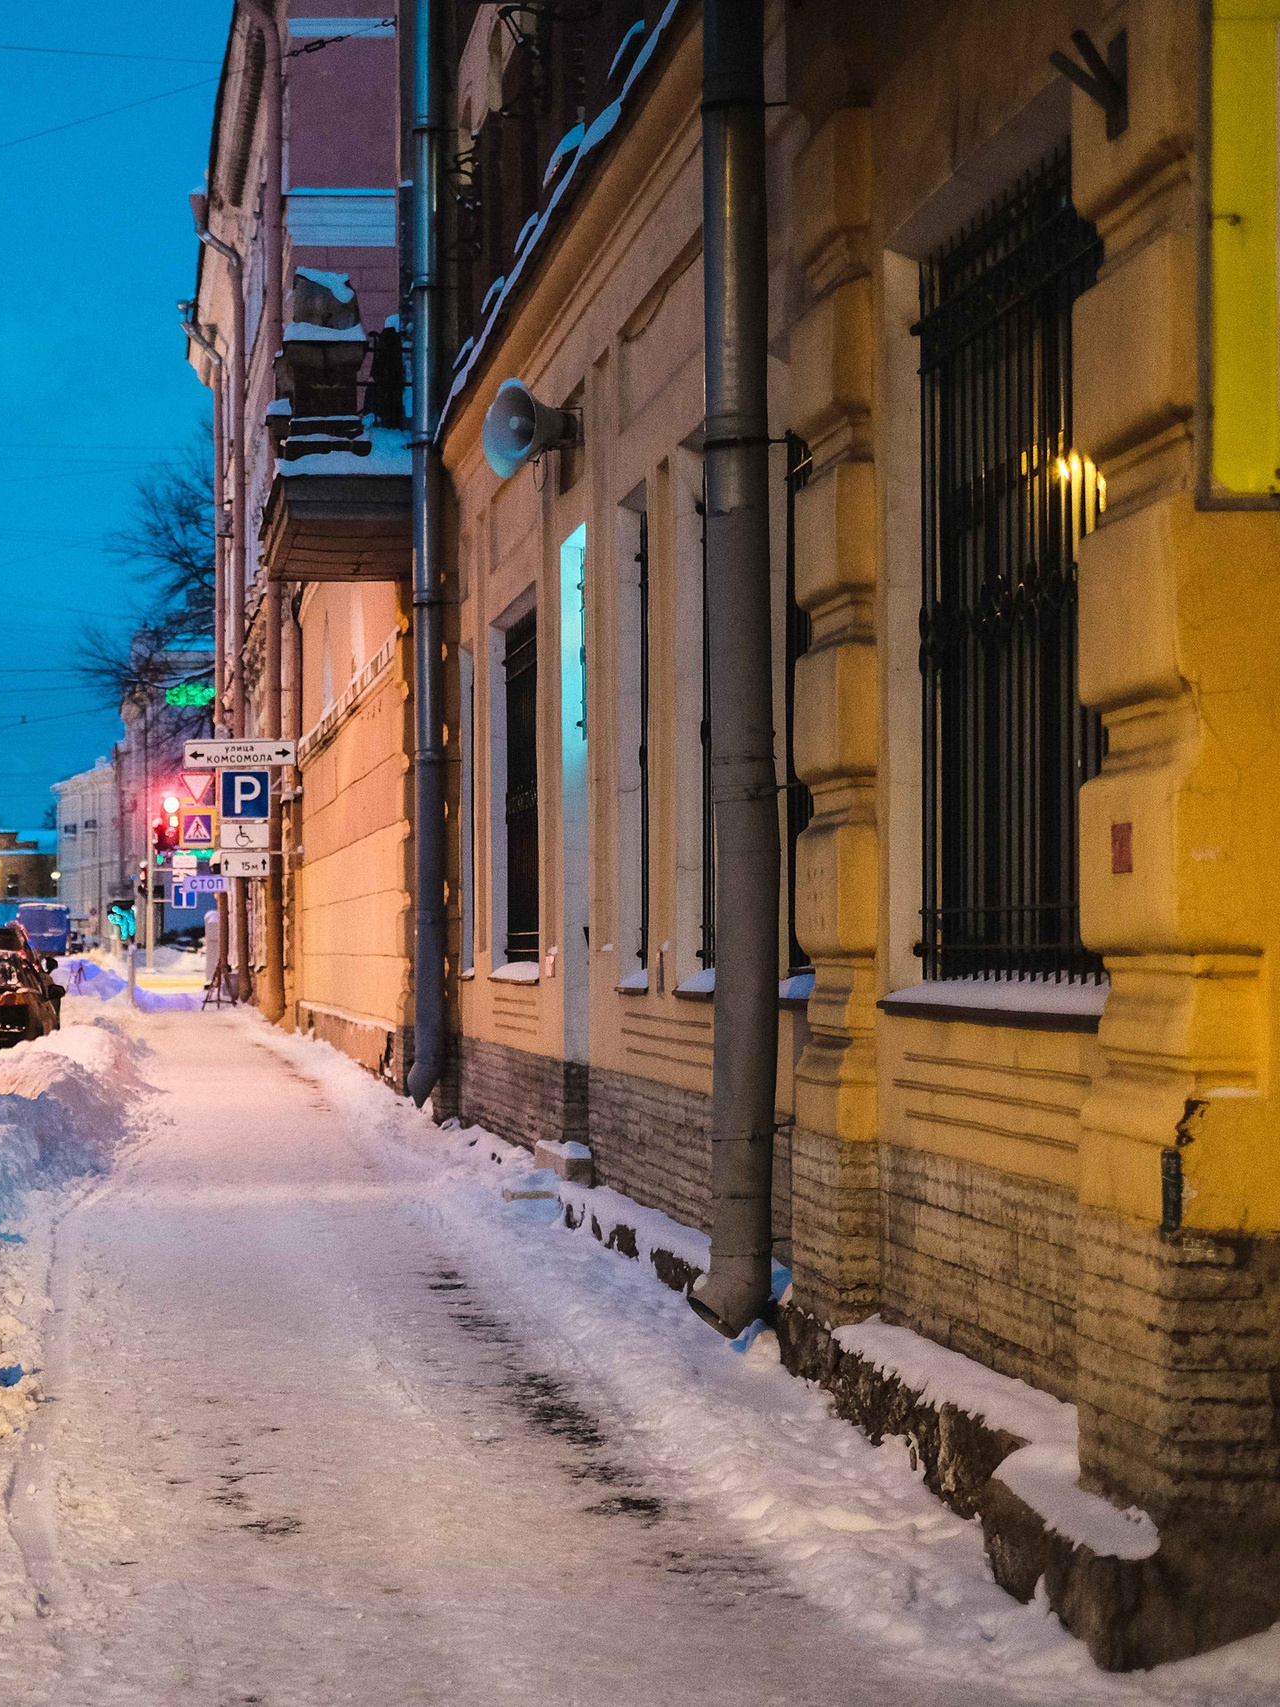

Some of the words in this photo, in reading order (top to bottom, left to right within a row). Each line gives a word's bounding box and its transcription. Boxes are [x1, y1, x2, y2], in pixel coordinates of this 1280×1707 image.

[224, 745, 254, 753] улица
[206, 754, 273, 764] КОМСОМОЛА
[234, 775, 261, 814] P
[189, 878, 224, 890] СТОП
